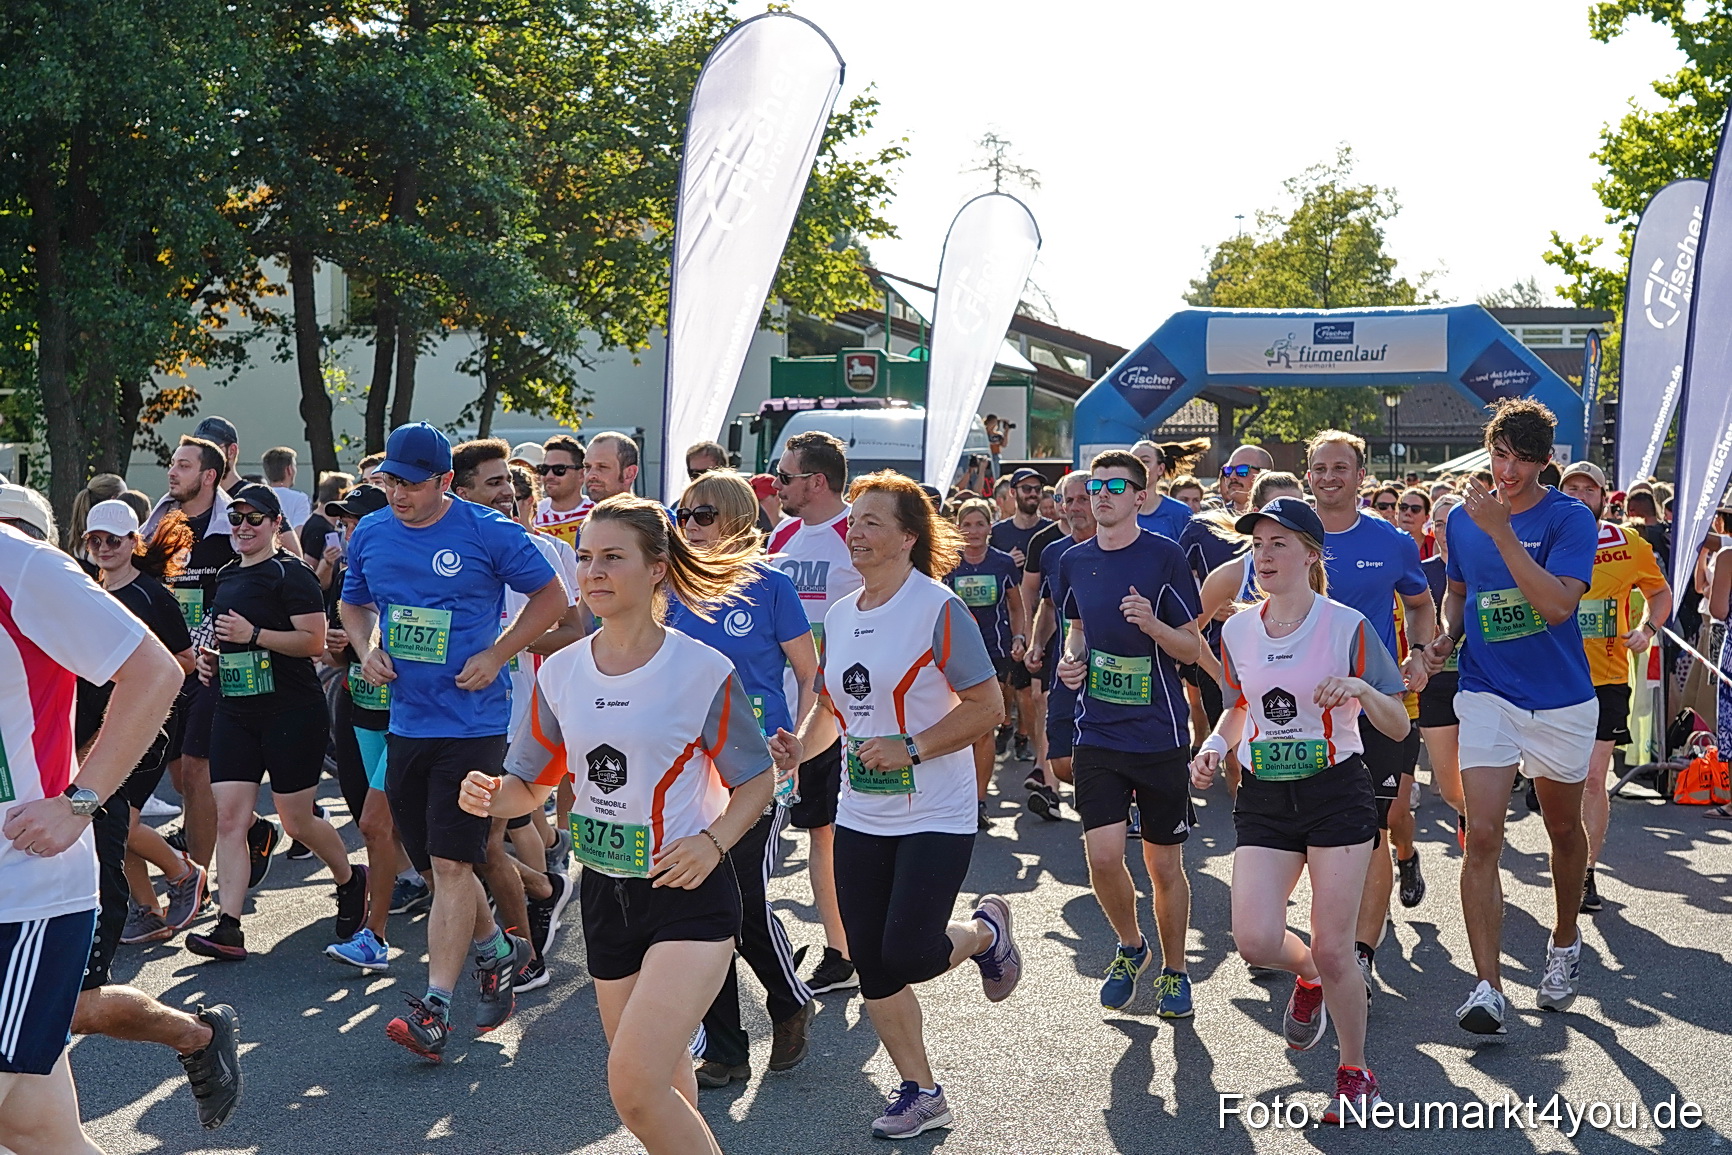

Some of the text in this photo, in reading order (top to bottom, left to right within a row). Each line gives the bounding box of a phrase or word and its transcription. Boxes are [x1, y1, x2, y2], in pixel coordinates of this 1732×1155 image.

[727, 54, 798, 201] Fischer
[1659, 205, 1703, 309] Fischer
[1299, 343, 1388, 362] firmenlauf
[1127, 373, 1176, 385] Fischer
[1593, 550, 1632, 565] BÖGL
[965, 586, 987, 597] 956
[1492, 605, 1525, 625] 456
[396, 624, 437, 644] 1757
[1512, 622, 1526, 630] Max
[436, 631, 446, 656] 2022
[1102, 670, 1133, 689] 961
[1141, 676, 1149, 698] 2022
[606, 699, 630, 707] spized
[1265, 727, 1303, 736] REISEMOBILE
[1254, 749, 1263, 770] RUN
[1268, 741, 1308, 762] 376
[1265, 762, 1314, 771] Deinhard Lisa
[594, 806, 617, 817] STROBL
[572, 823, 580, 848] RUN
[584, 818, 625, 849] 375
[607, 850, 631, 862] Maria
[635, 830, 645, 867] 2022
